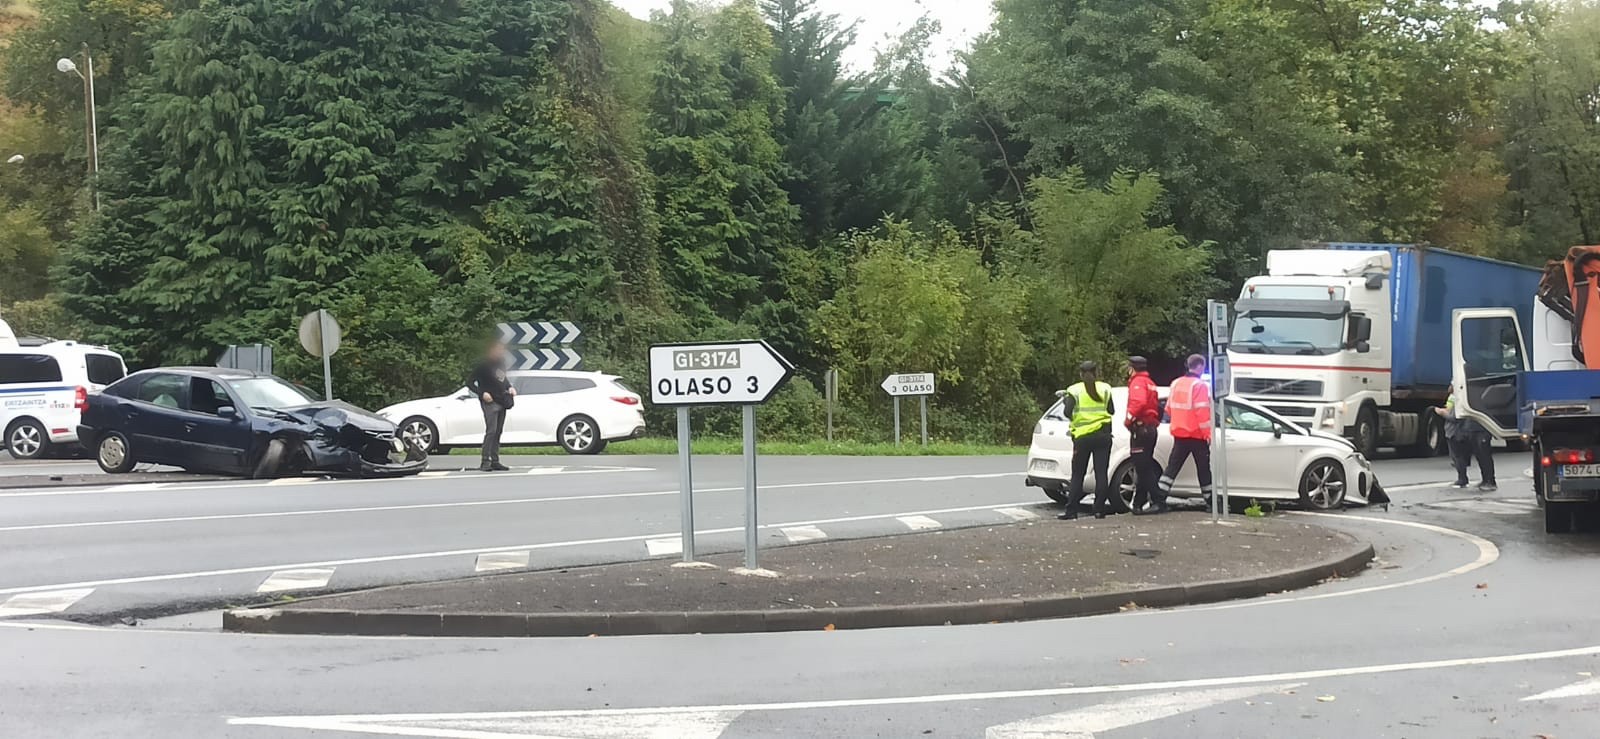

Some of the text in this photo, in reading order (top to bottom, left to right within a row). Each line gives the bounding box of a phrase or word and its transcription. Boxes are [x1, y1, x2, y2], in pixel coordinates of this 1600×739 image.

[675, 351, 738, 368] GI-3174
[658, 375, 759, 396] OLASO 3
[902, 384, 932, 393] OLASO
[1564, 465, 1593, 475] 5074
